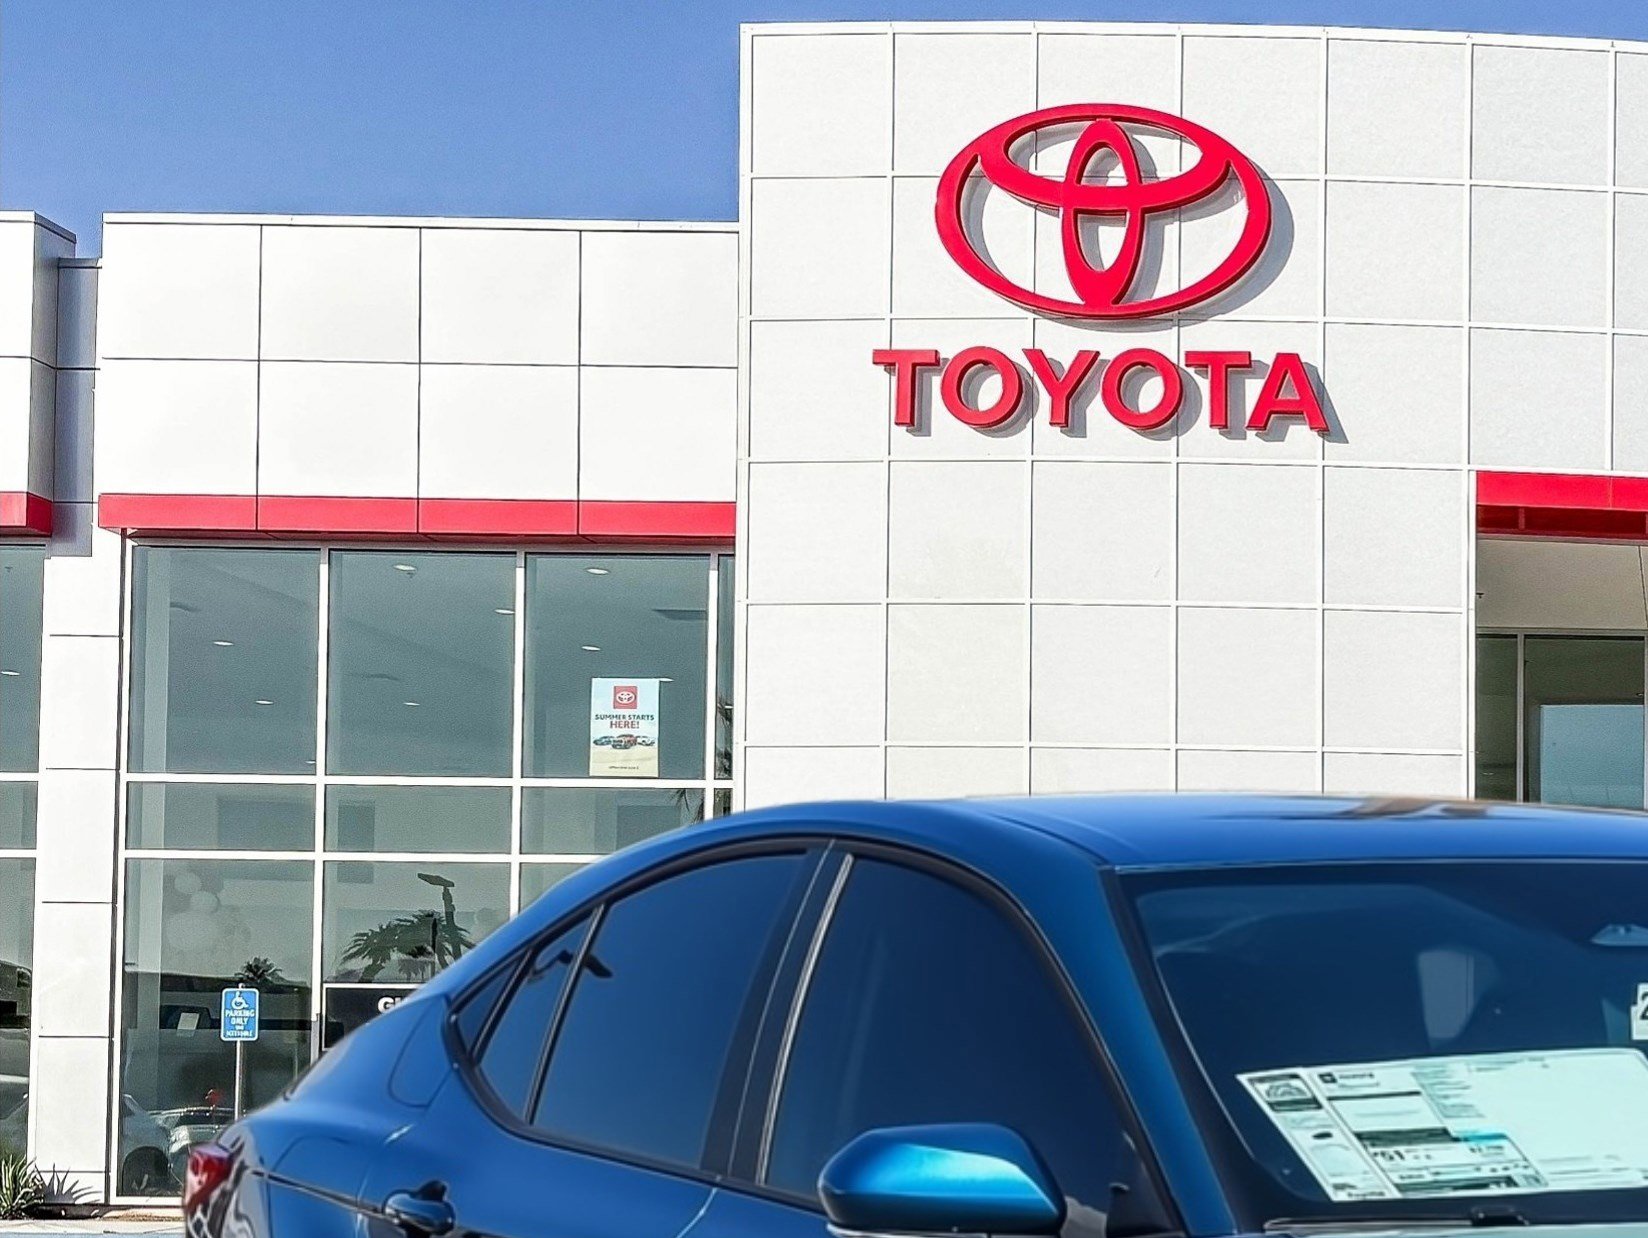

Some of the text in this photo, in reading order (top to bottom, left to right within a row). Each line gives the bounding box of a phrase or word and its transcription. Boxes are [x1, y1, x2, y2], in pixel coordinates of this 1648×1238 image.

[872, 345, 1331, 432] TOYOTA
[609, 721, 640, 729] HERE!
[225, 1009, 255, 1017] PARKING
[230, 1017, 249, 1025] ONLY
